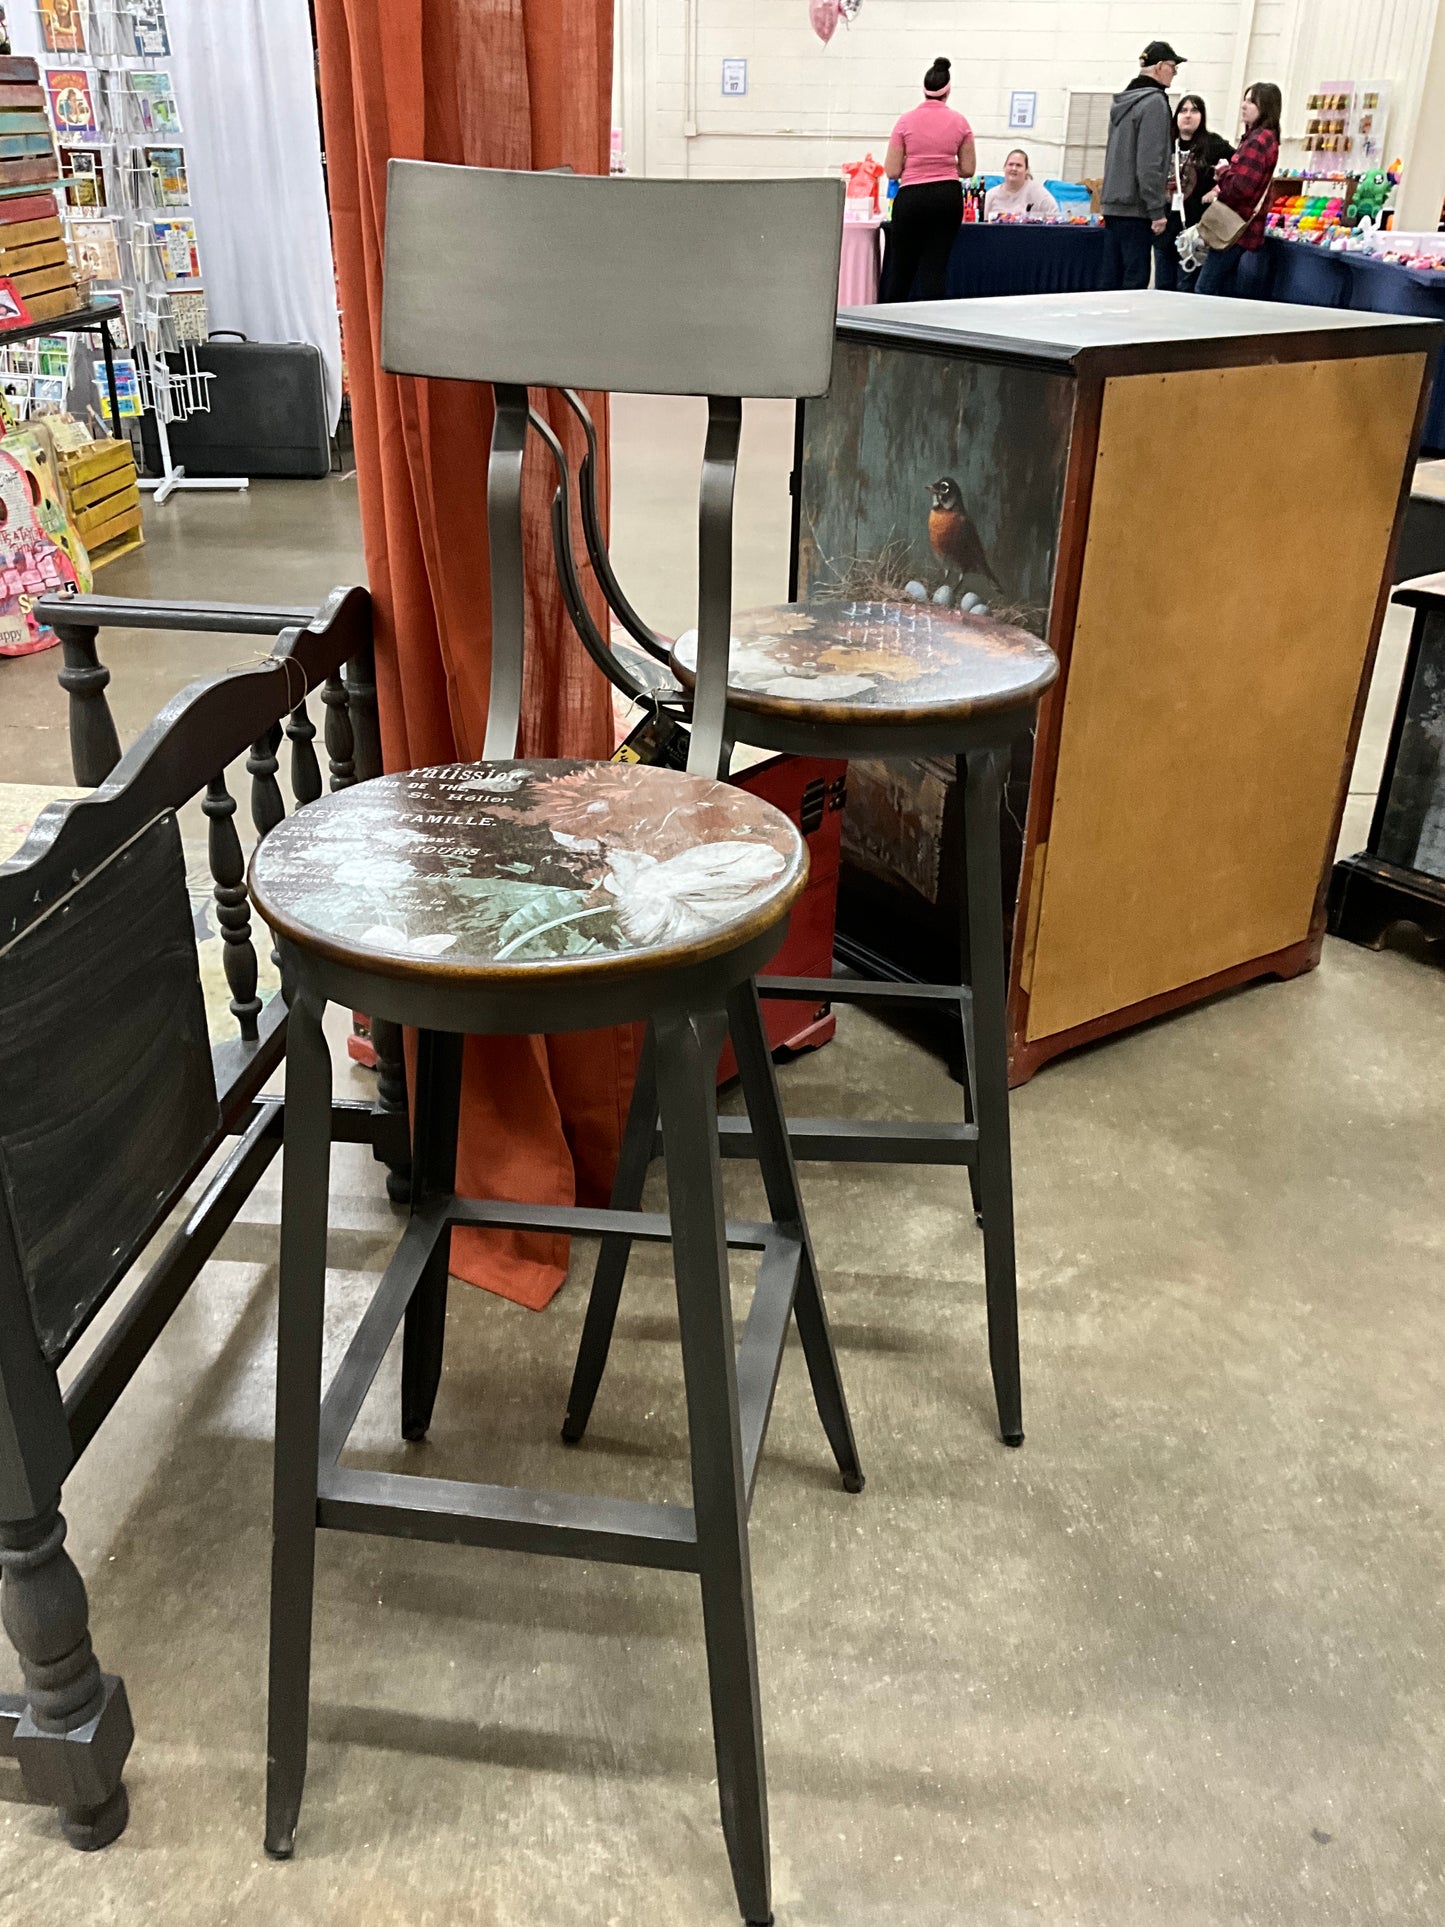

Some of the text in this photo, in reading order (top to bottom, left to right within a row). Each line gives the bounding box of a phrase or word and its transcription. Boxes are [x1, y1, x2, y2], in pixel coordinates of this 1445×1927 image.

[407, 782, 429, 791] DE
[407, 791, 437, 800] St.
[398, 813, 498, 827] FAMILLE.
